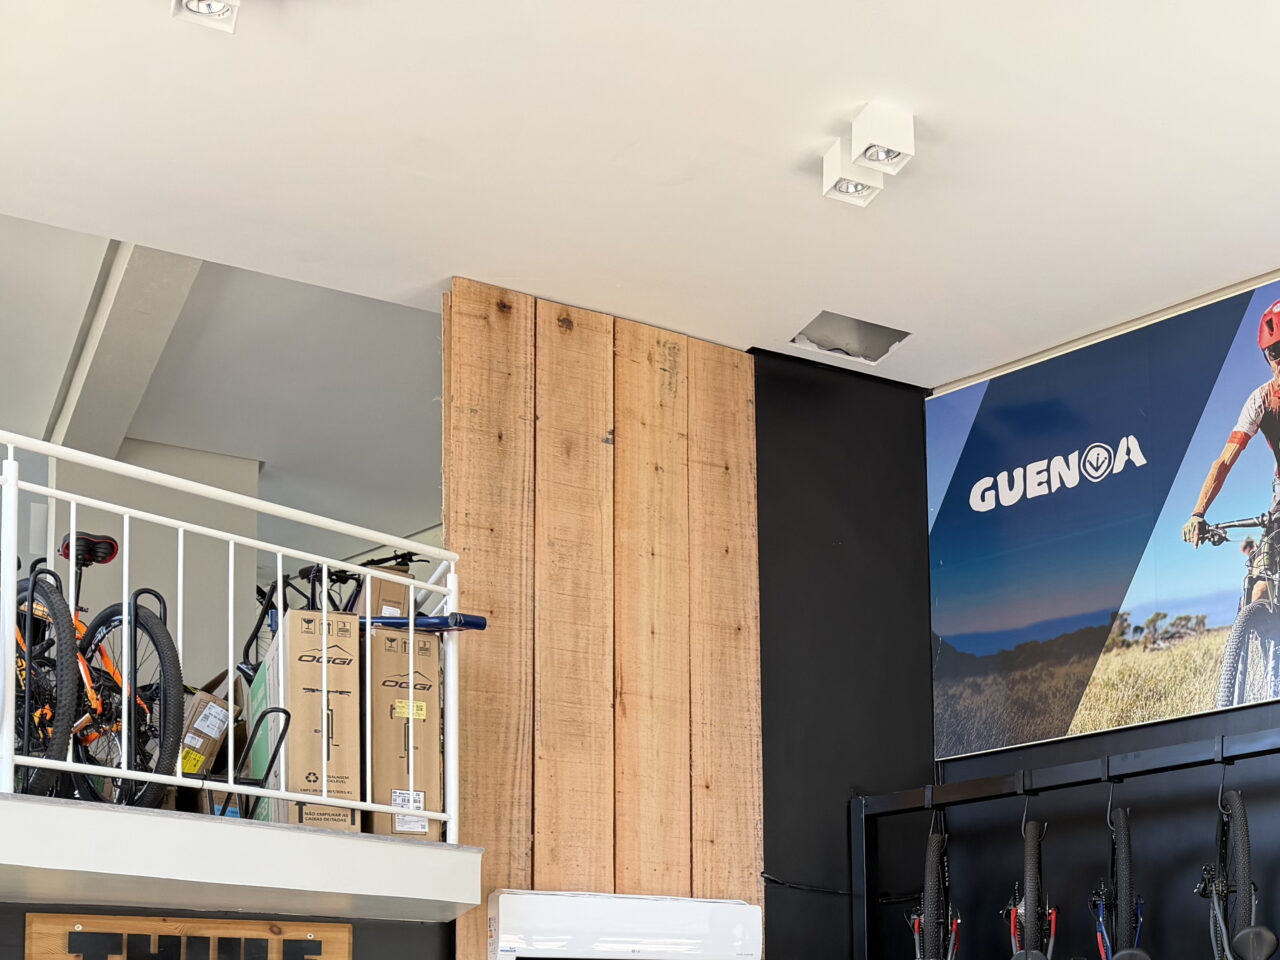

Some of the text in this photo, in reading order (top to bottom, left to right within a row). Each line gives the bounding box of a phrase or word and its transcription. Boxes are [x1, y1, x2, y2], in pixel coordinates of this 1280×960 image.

[969, 434, 1147, 512] GUENOA
[298, 654, 353, 666] OGGI
[381, 679, 433, 692] OGGI
